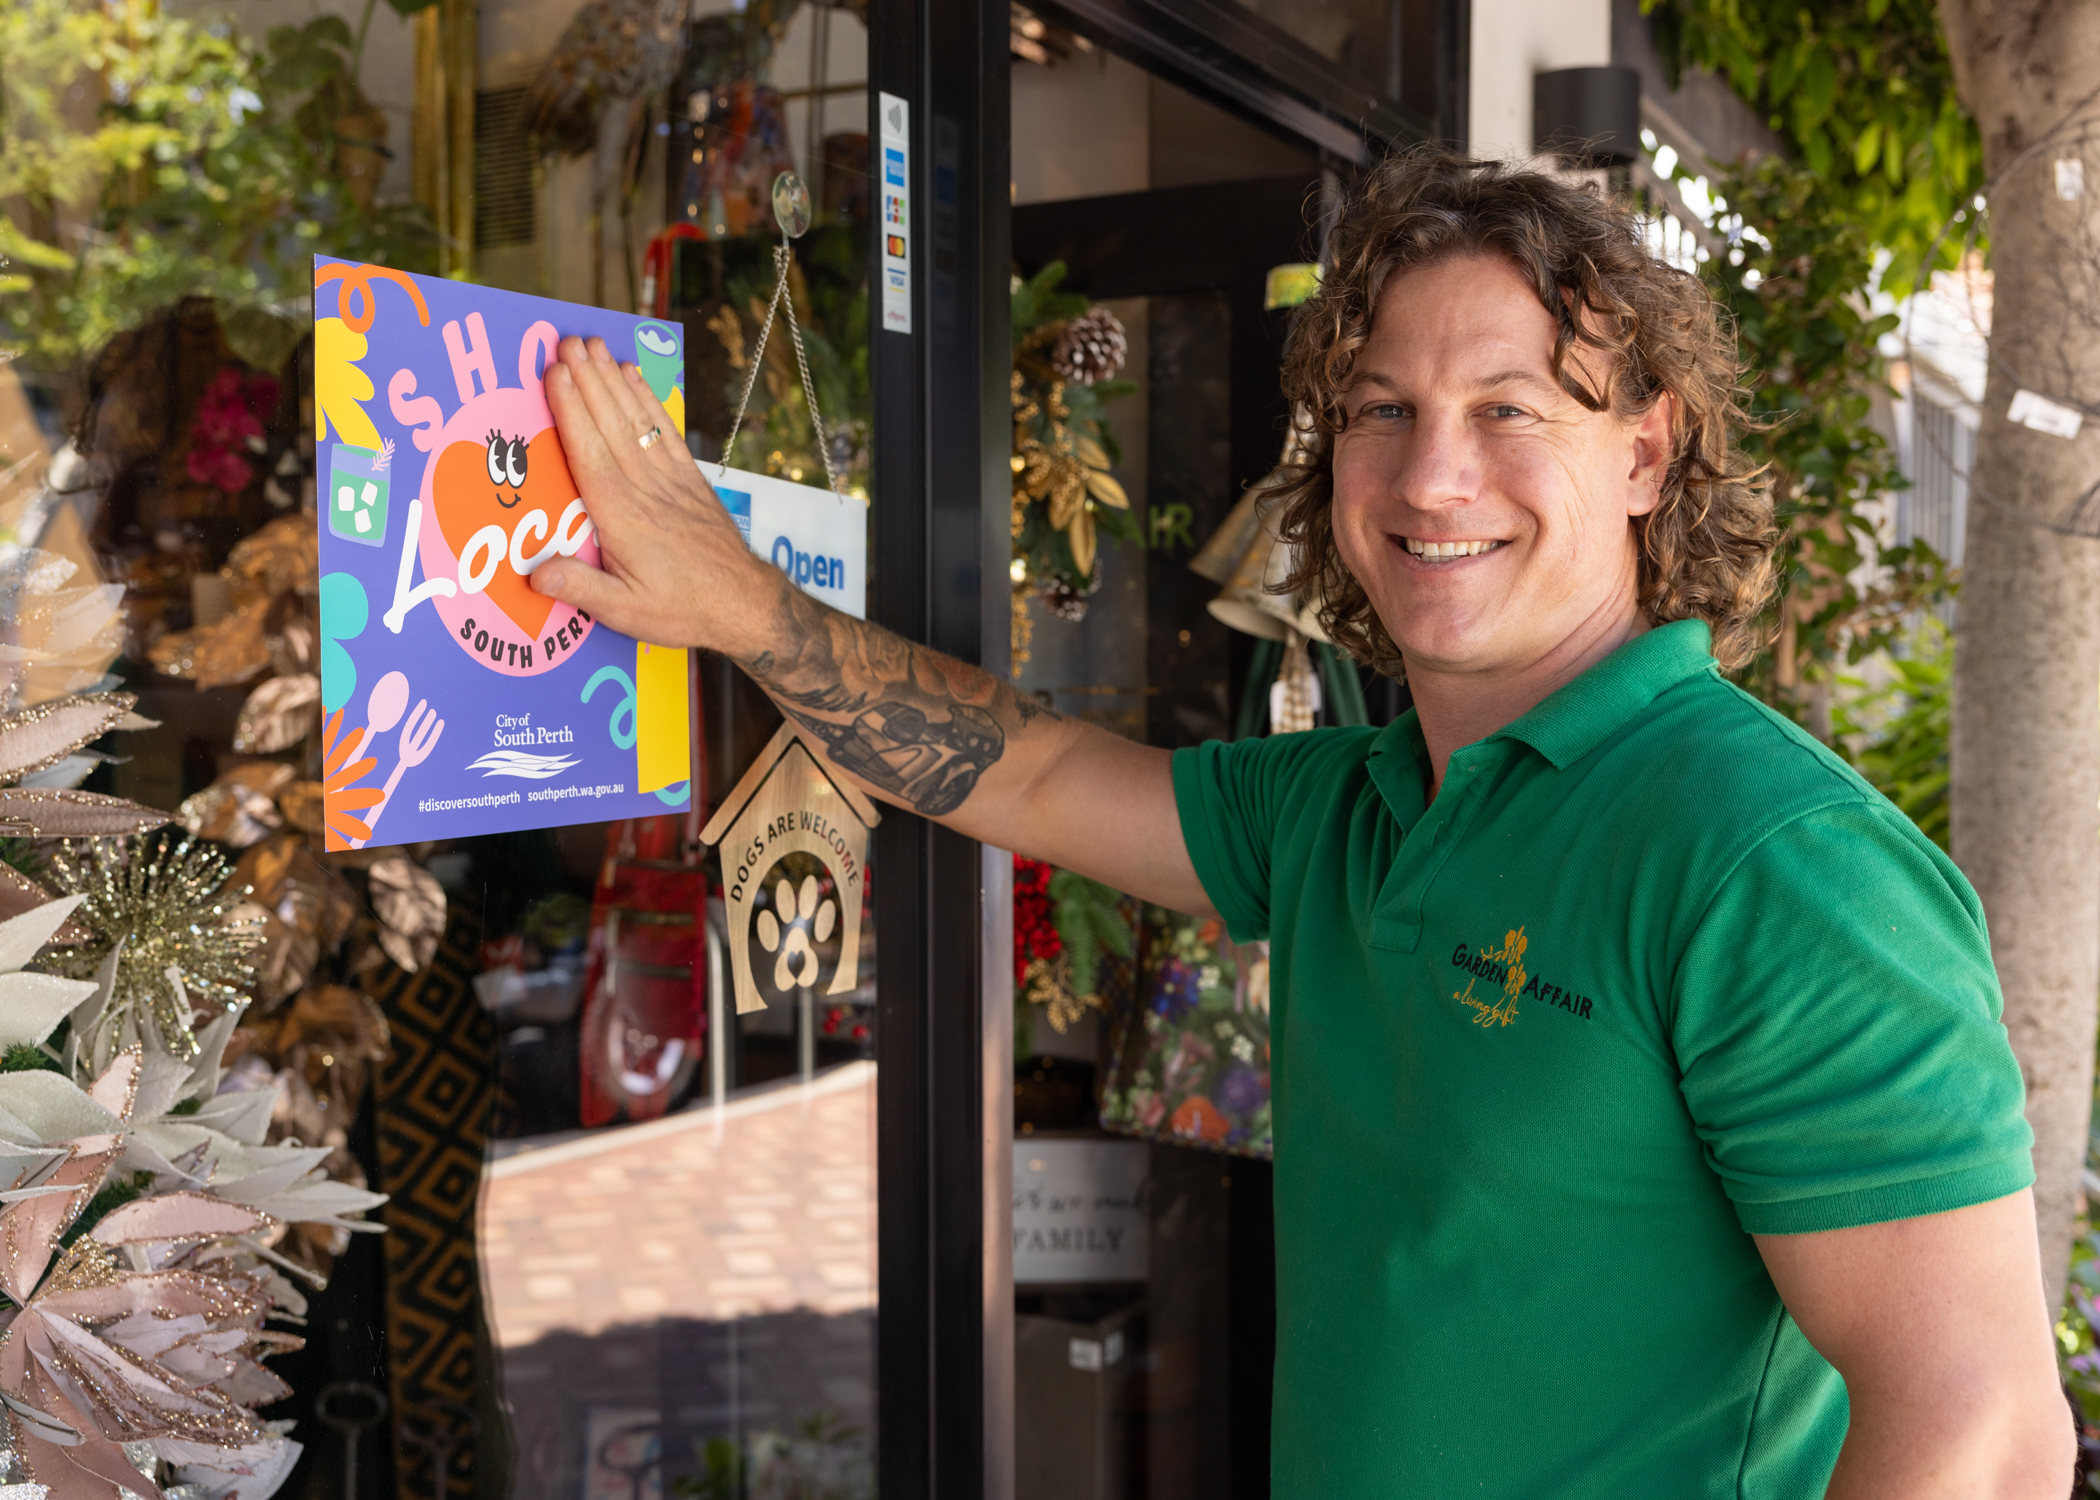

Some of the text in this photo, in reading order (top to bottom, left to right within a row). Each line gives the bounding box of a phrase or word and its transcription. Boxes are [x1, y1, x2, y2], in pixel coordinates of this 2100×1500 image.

[388, 312, 560, 453] SHO
[383, 497, 601, 634] Loca
[771, 535, 845, 590] Open
[460, 608, 591, 669] SOUTH PERT
[493, 725, 574, 747] South Perth
[495, 712, 531, 731] City of
[418, 783, 624, 813] #discoversouthperth southperth.wa.gov.au
[730, 810, 860, 903] DOGS ARE WELCOME
[1451, 943, 1593, 1020] GARDEN AFFAIR
